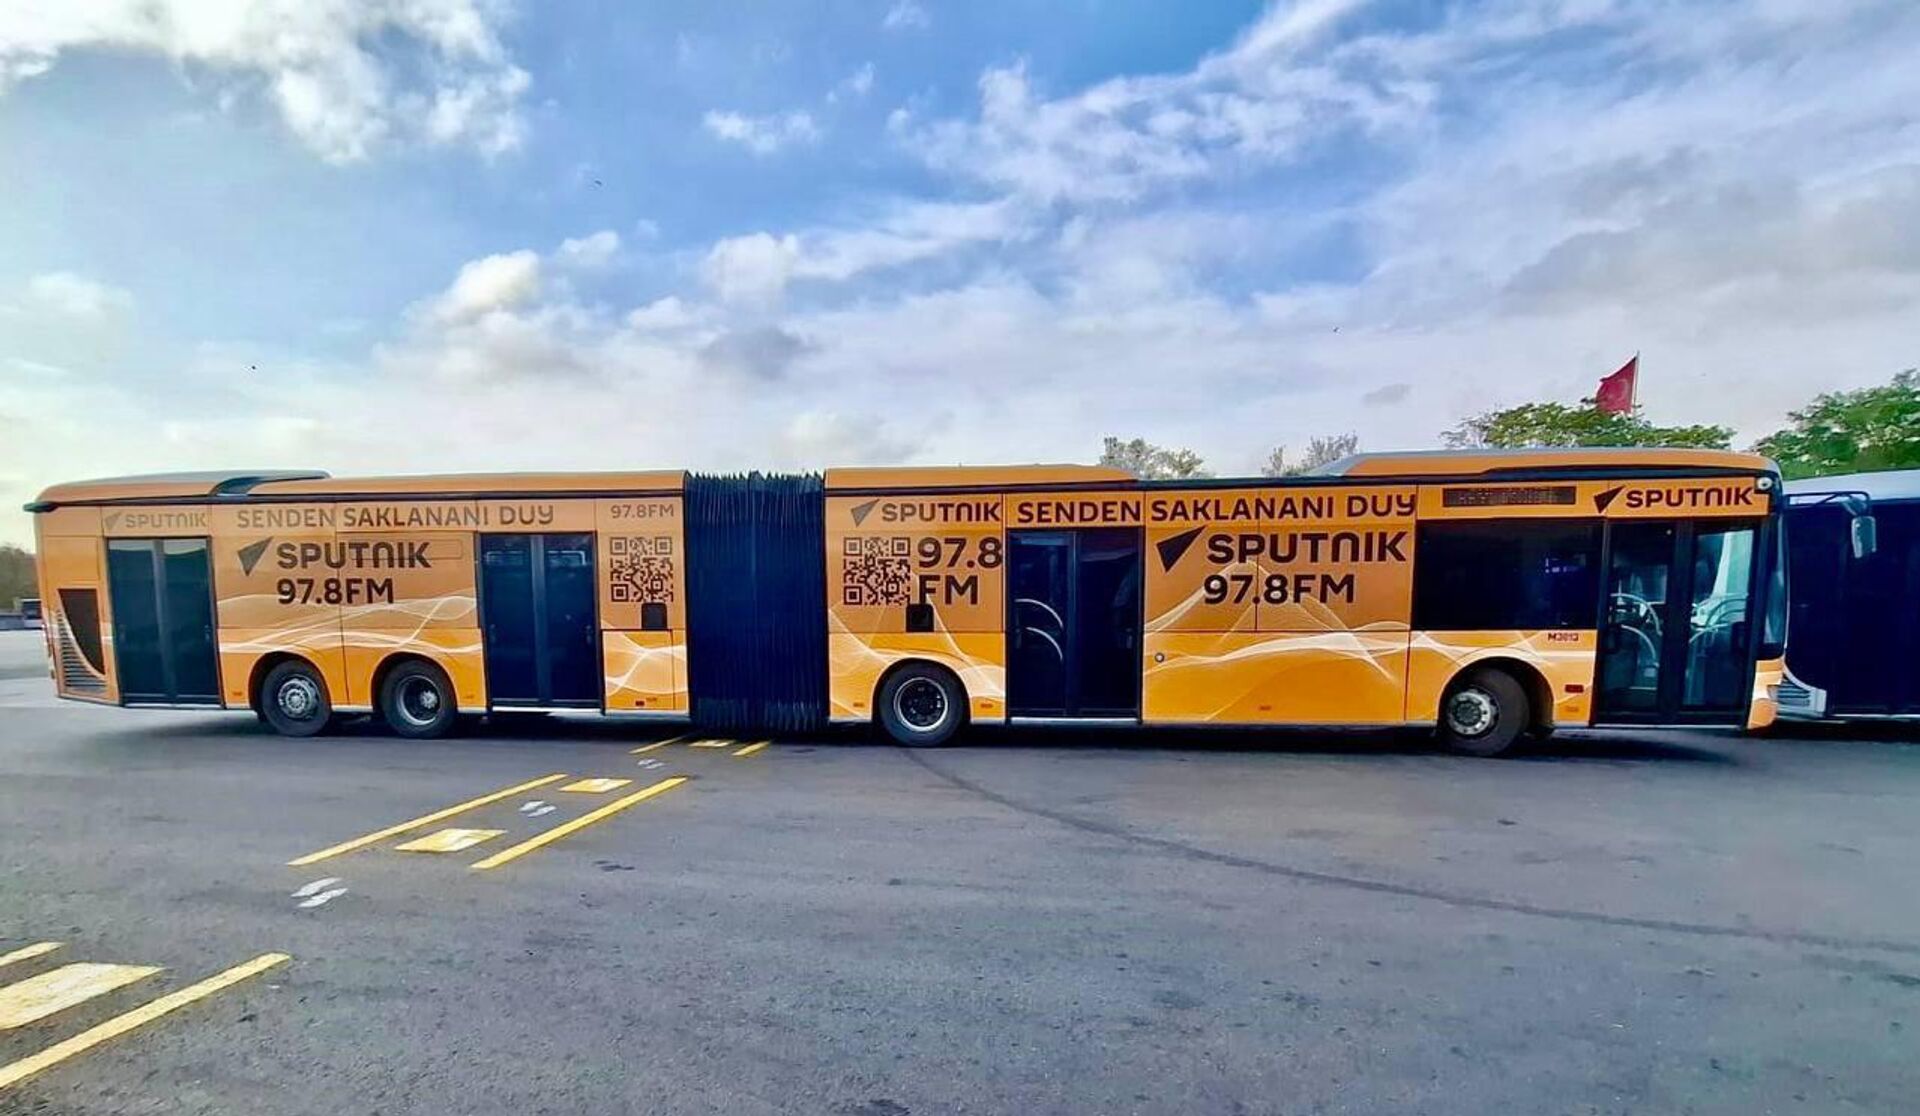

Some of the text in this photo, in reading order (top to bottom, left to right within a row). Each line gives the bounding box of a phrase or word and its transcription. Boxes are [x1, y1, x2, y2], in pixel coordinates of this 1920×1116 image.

[610, 503, 674, 519] 97.8FM
[1017, 493, 1416, 523] SENDEN SAKLANANI DUY
[1626, 487, 1753, 508] SPUTNIK
[125, 512, 207, 529] SPUTNIK
[237, 504, 554, 528] SENDEN SAKLANANI DUY
[882, 502, 1000, 522] SPUTNIK
[276, 542, 432, 569] SPUTNIK
[917, 537, 1003, 568] 97.8
[1207, 531, 1409, 563] SPUTNIK
[277, 577, 394, 604] 97.8FM
[918, 575, 979, 605] FM
[1204, 574, 1355, 604] 97.8FM
